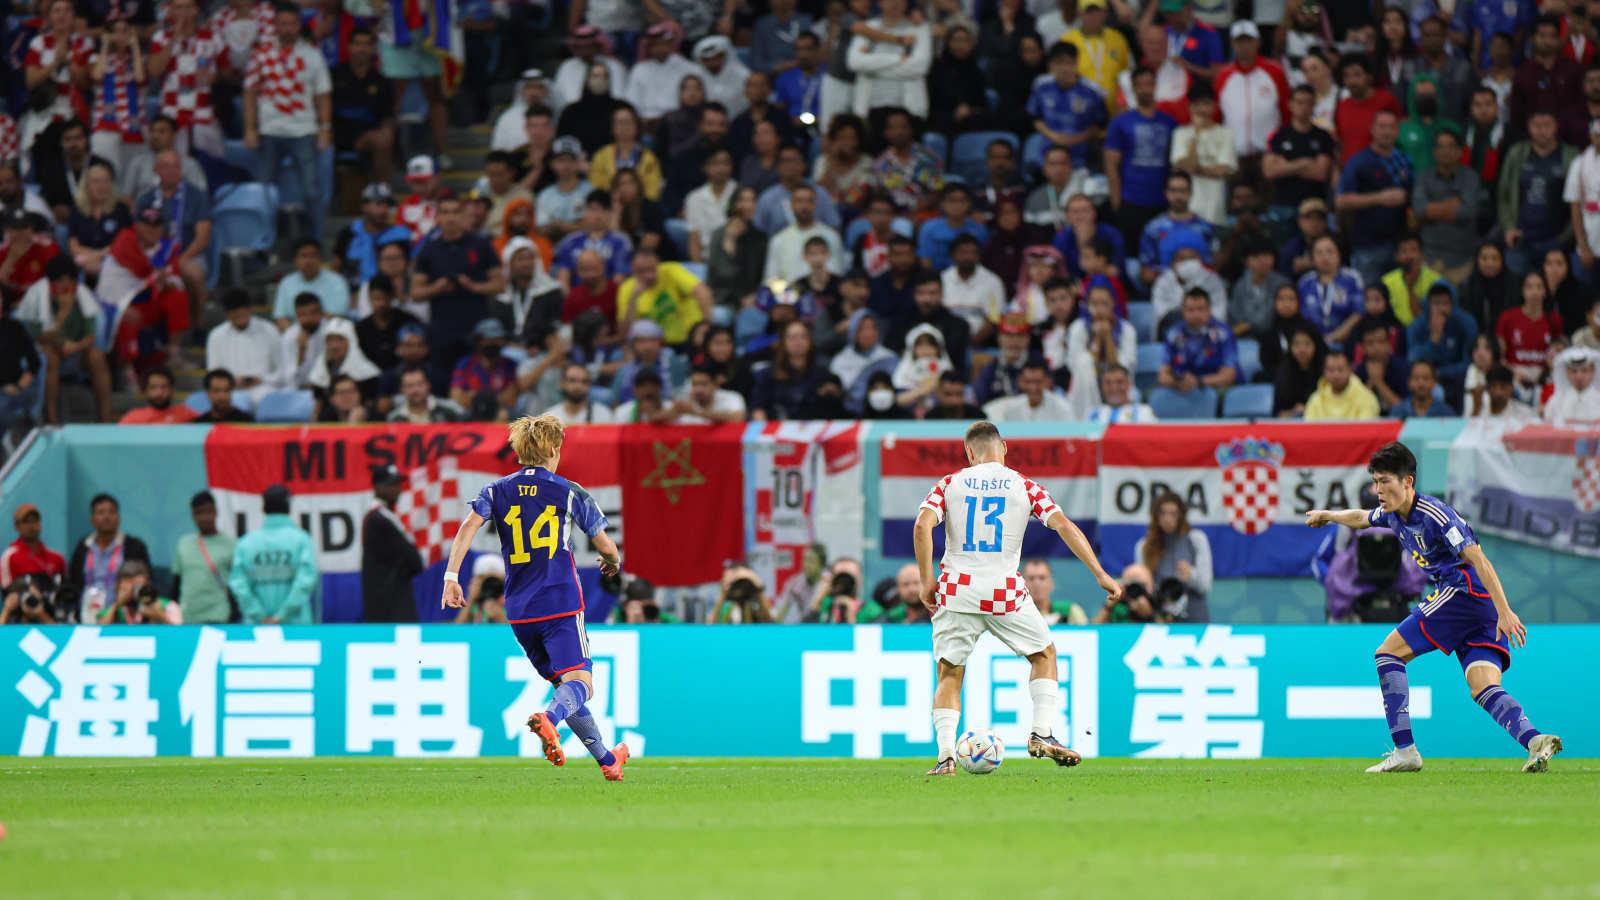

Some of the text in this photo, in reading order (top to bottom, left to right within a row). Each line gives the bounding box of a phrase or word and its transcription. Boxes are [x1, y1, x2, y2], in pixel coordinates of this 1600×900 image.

[283, 440, 346, 482] MI
[517, 484, 539, 497] ITO
[503, 504, 560, 565] 14
[962, 495, 1006, 553] 13
[16, 624, 1432, 758] 海信电视 中国第一
